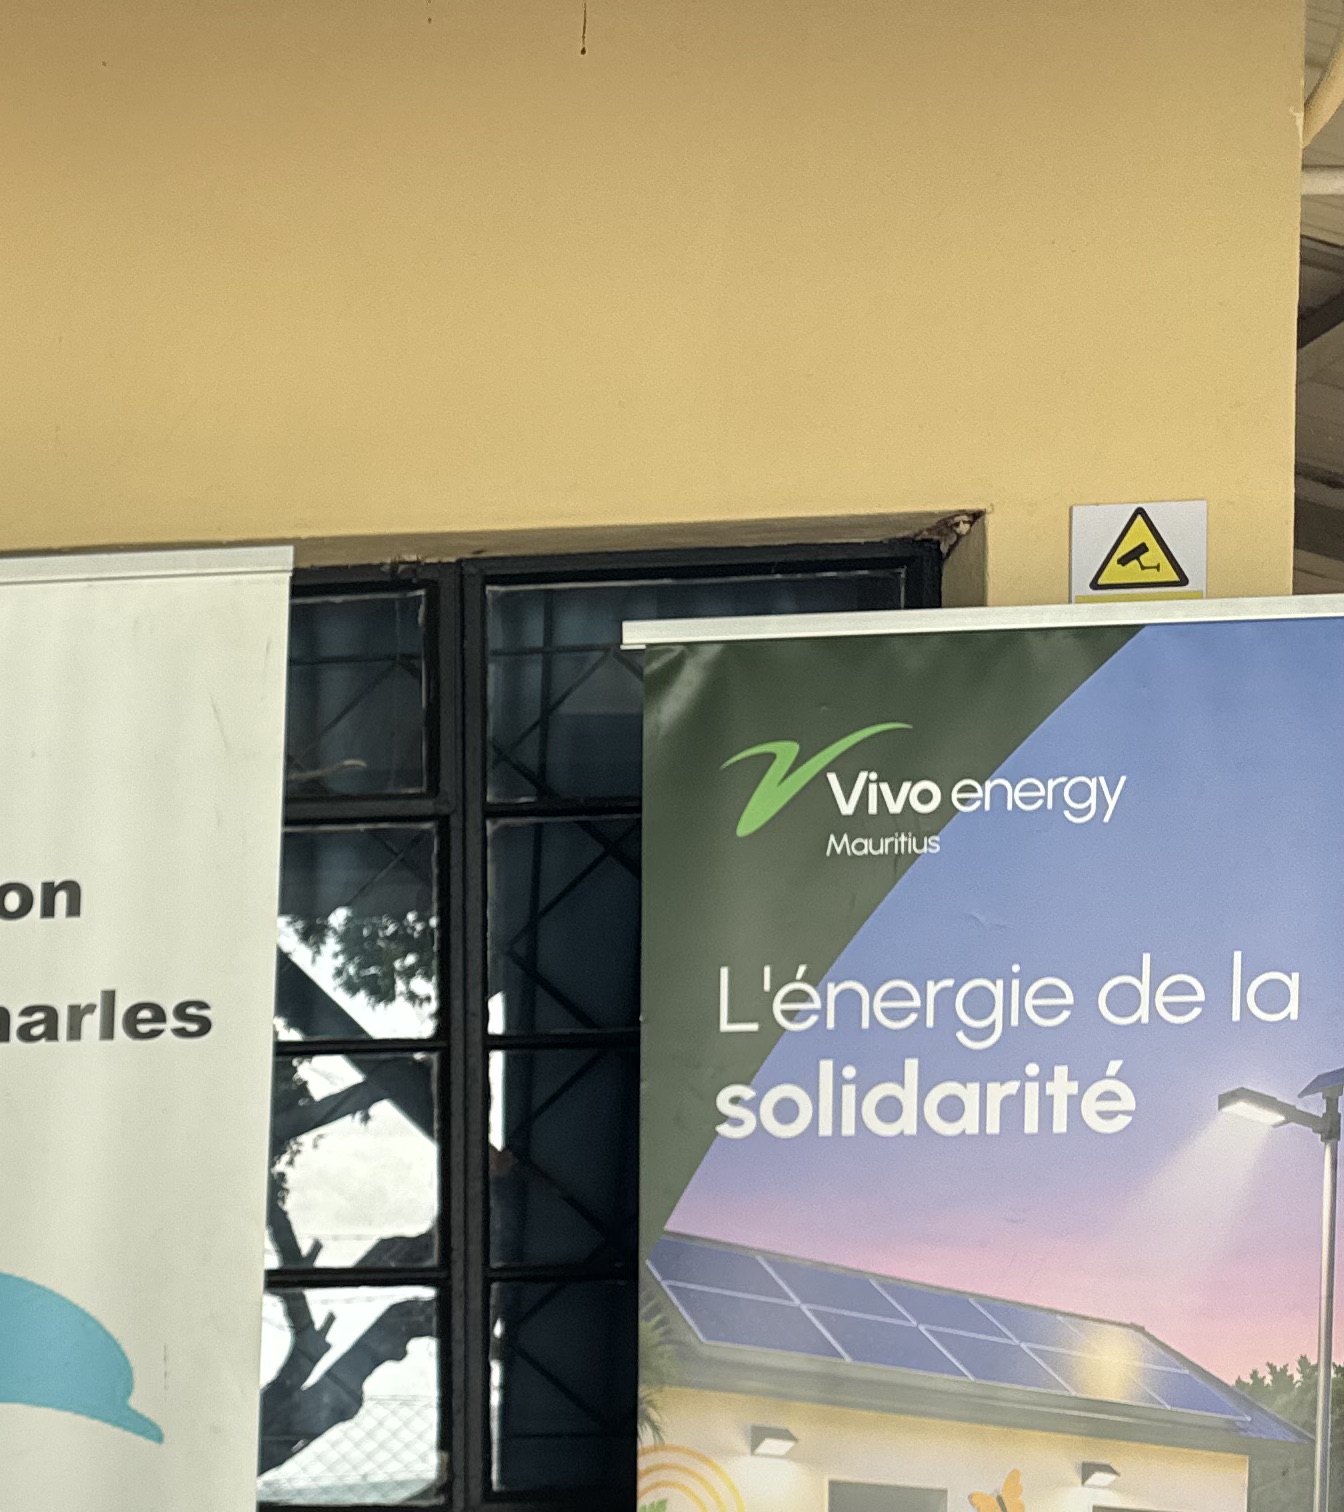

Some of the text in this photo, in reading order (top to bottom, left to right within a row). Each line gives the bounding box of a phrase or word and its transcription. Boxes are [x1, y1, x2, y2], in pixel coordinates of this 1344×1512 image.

[826, 770, 1127, 824] Vivo energy
[826, 832, 941, 858] Mauritius
[719, 950, 1300, 1050] L'énergie de la
[715, 1058, 1137, 1140] solidarité
